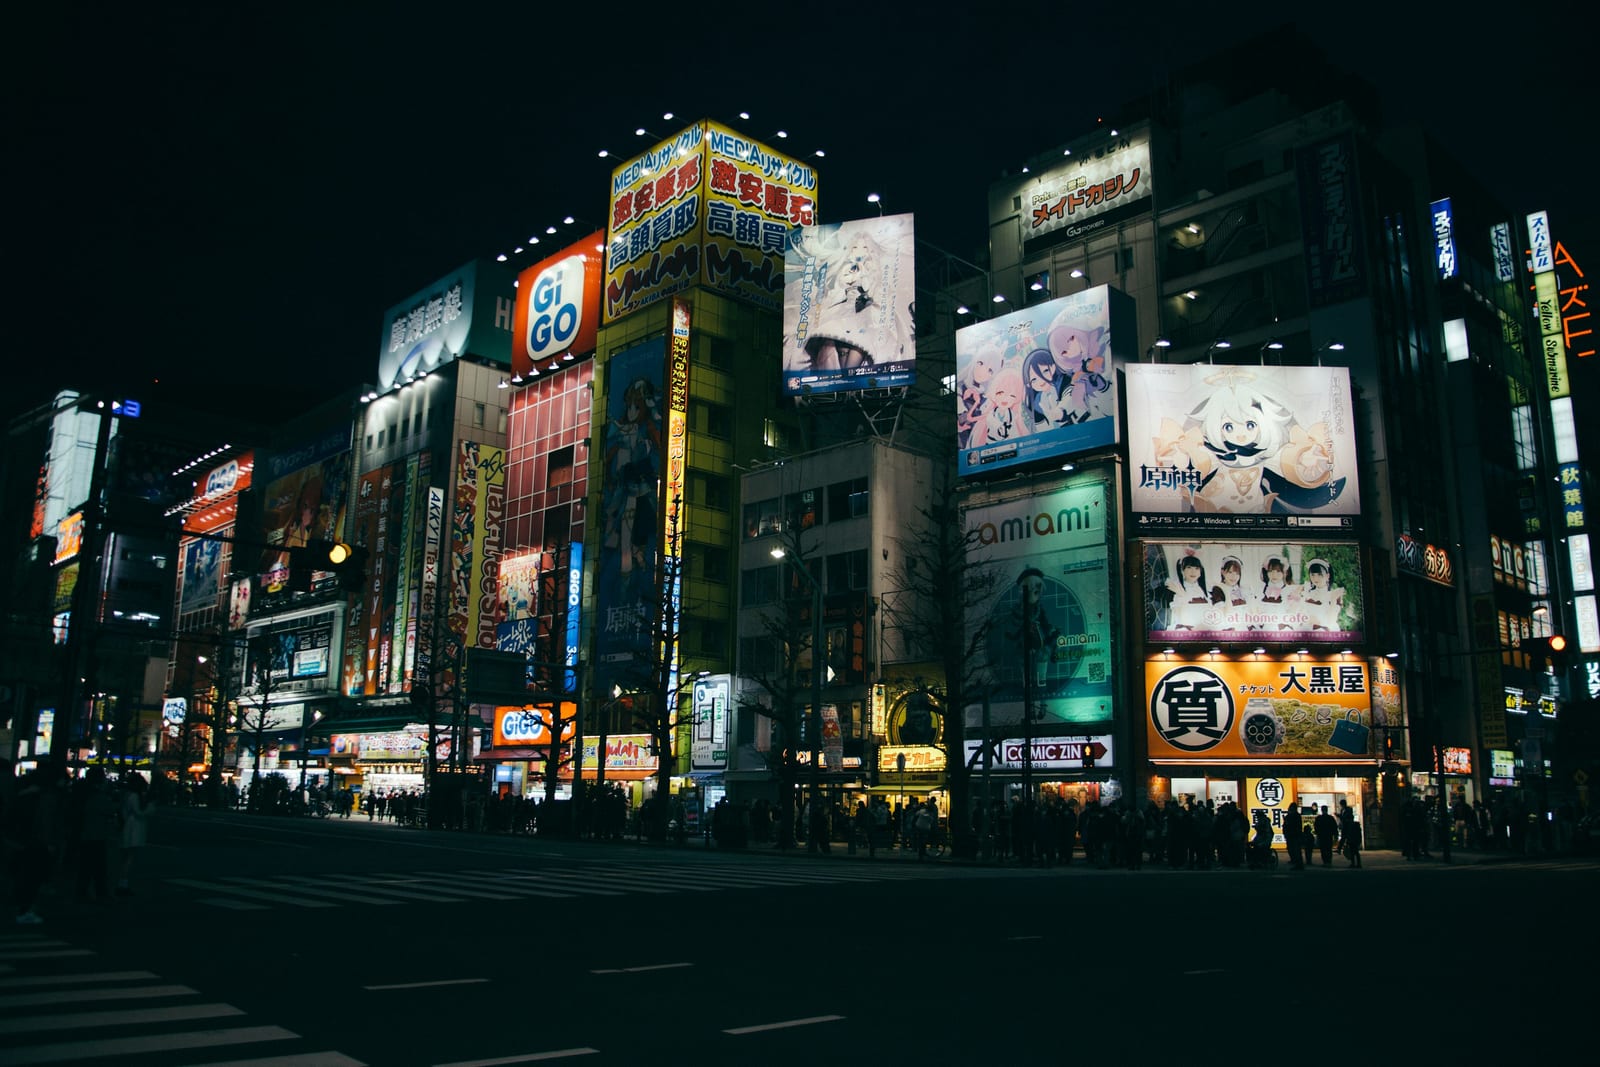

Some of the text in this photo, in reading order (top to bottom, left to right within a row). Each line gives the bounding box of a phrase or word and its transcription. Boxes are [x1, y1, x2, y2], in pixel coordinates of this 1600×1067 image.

[614, 124, 701, 191] MEDIAリサイクル
[710, 132, 815, 191] MEDIAリサイクル
[612, 156, 700, 230] 激安販売
[710, 159, 814, 227] 激安販売
[1032, 168, 1140, 229] メイドカジノ
[609, 198, 698, 271] 高額買取
[534, 270, 563, 313] Gi
[607, 245, 699, 317] Mulan
[530, 303, 577, 353] GO
[674, 337, 688, 347] DVD
[1540, 299, 1561, 393] Yellow Submarine
[360, 479, 373, 498] 4F
[1139, 459, 1202, 503] 原神
[428, 491, 441, 537] AKKY
[979, 505, 1091, 545] amiami
[1203, 516, 1231, 525] Windows
[371, 559, 383, 615] Hey
[425, 549, 438, 611] Tax-free
[349, 607, 361, 627] 2F
[1227, 612, 1309, 623] at home cafe
[1056, 633, 1101, 648] amiami
[1239, 684, 1275, 694] チケット
[1279, 666, 1366, 694] 大黒屋
[503, 715, 541, 736] GiGO
[1162, 679, 1223, 742] 質
[1060, 745, 1081, 760] ZIN
[1259, 781, 1280, 802] 質
